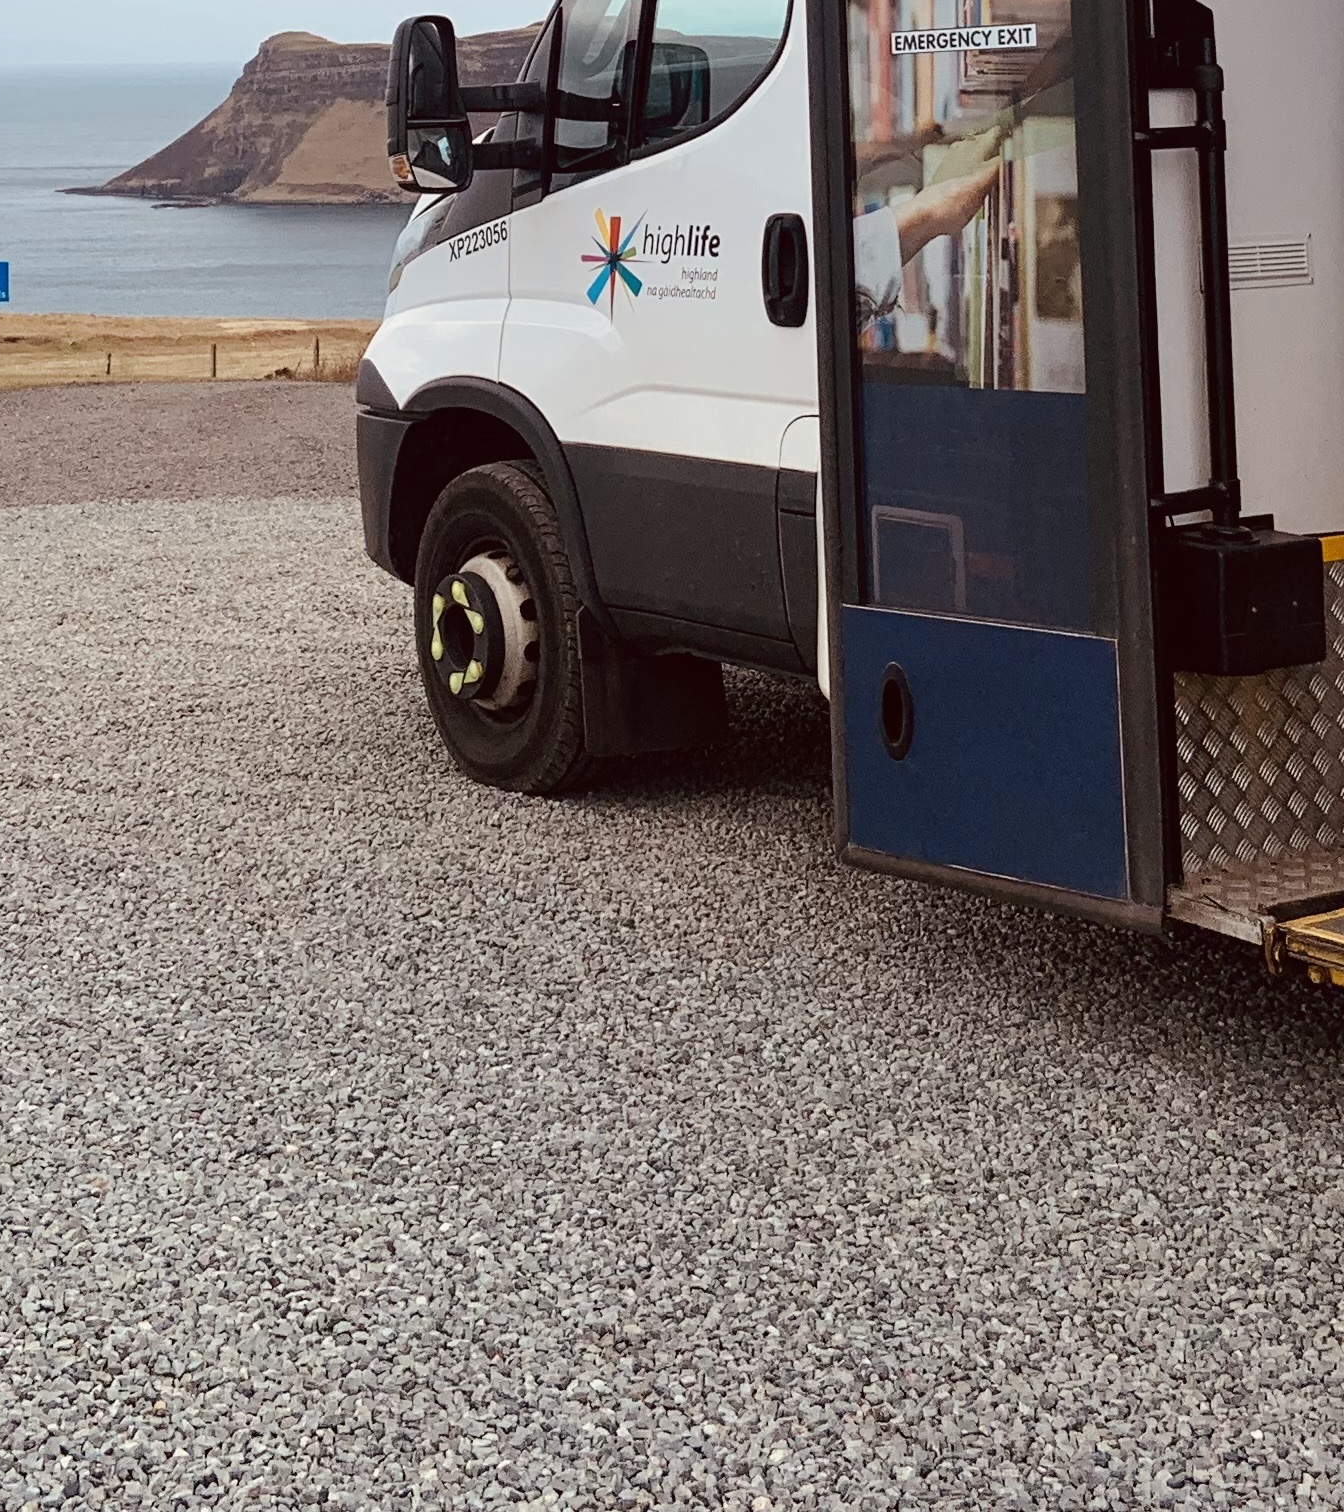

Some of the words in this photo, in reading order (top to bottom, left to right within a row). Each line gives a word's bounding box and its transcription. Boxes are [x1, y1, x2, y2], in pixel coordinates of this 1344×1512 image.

[894, 30, 992, 51] EMERGENCY
[997, 27, 1032, 45] EXIT
[448, 220, 508, 262] XP223056
[681, 267, 719, 283] highland
[646, 286, 657, 296] na
